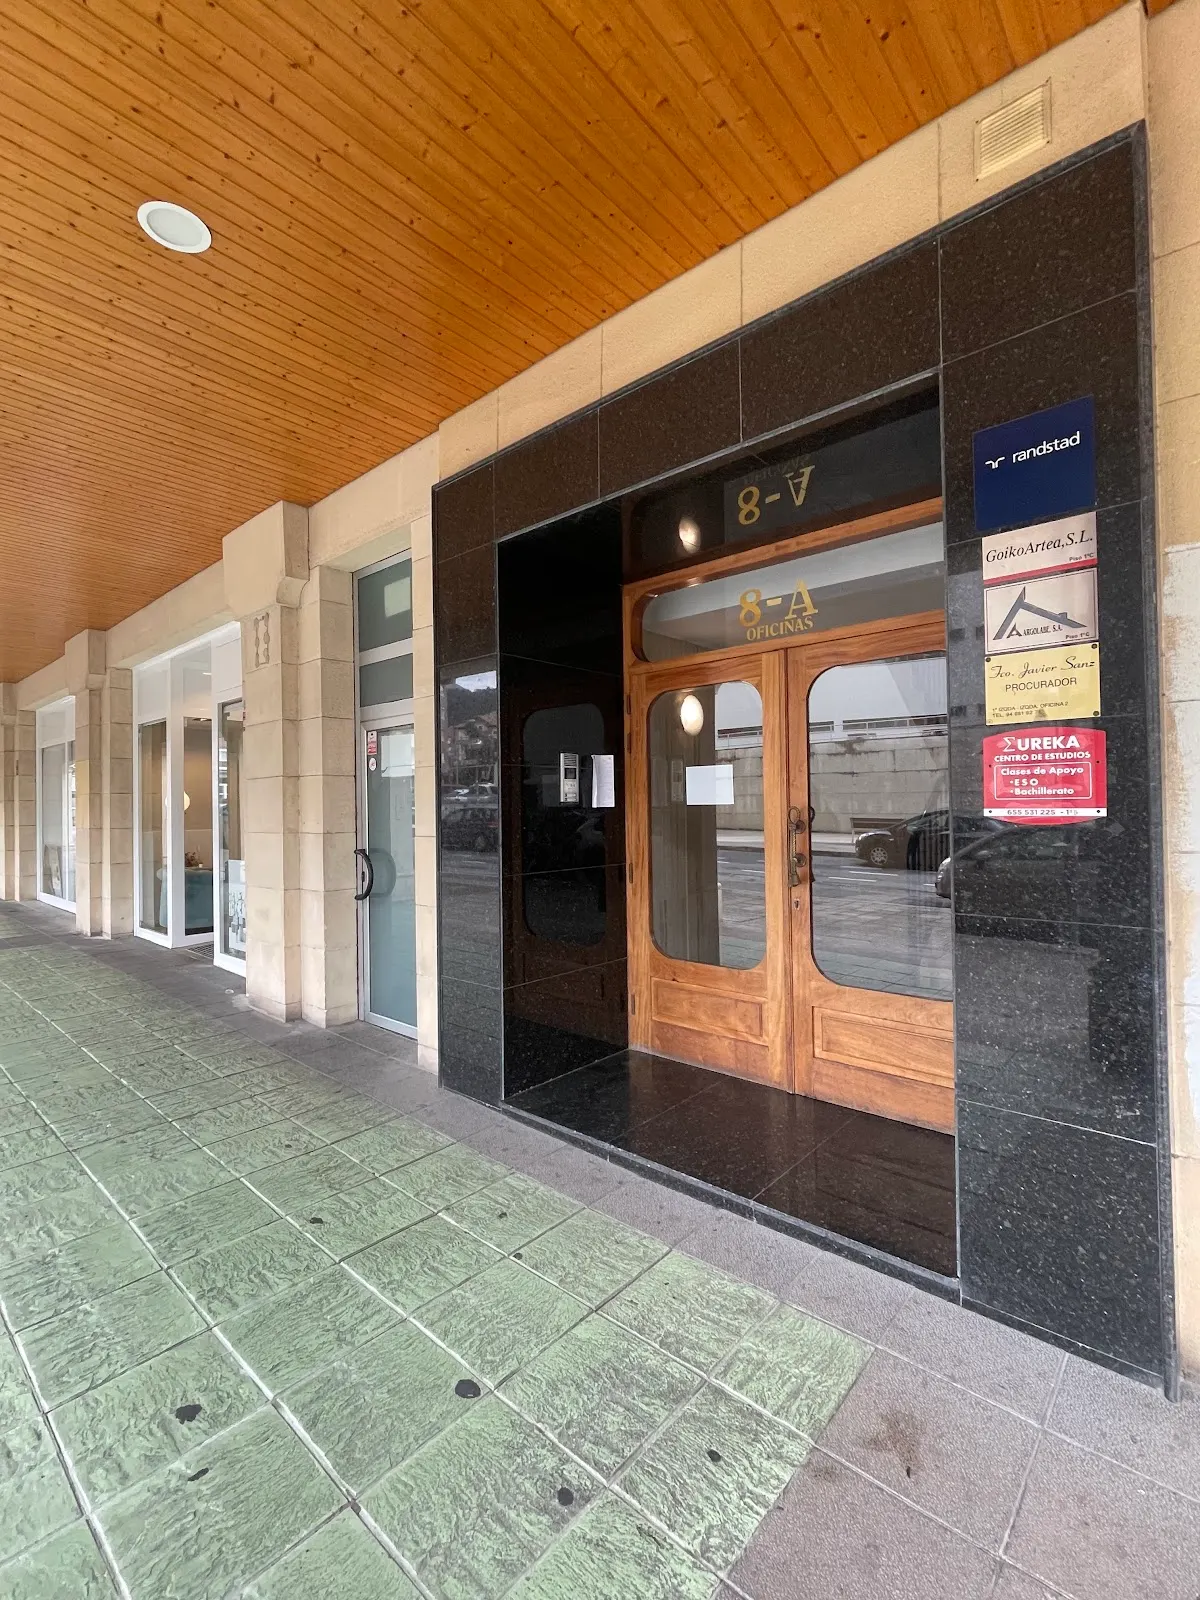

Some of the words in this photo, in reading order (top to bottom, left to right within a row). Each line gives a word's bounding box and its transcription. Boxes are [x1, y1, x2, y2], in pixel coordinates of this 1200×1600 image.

[1012, 430, 1081, 463] randstad
[739, 579, 819, 627] 8-A
[746, 615, 814, 641] OFICINAS
[1018, 663, 1058, 679] Javier
[1061, 656, 1096, 671] Sanz
[1005, 677, 1077, 692] PROCURADOR
[1040, 701, 1064, 709] OFICINA
[994, 753, 1030, 763] CENTRO
[1031, 753, 1043, 761] DE
[1045, 751, 1091, 760] ESTUDIOS
[1001, 767, 1032, 776] Clases
[1033, 766, 1047, 775] de
[1048, 766, 1084, 775] Apoyo
